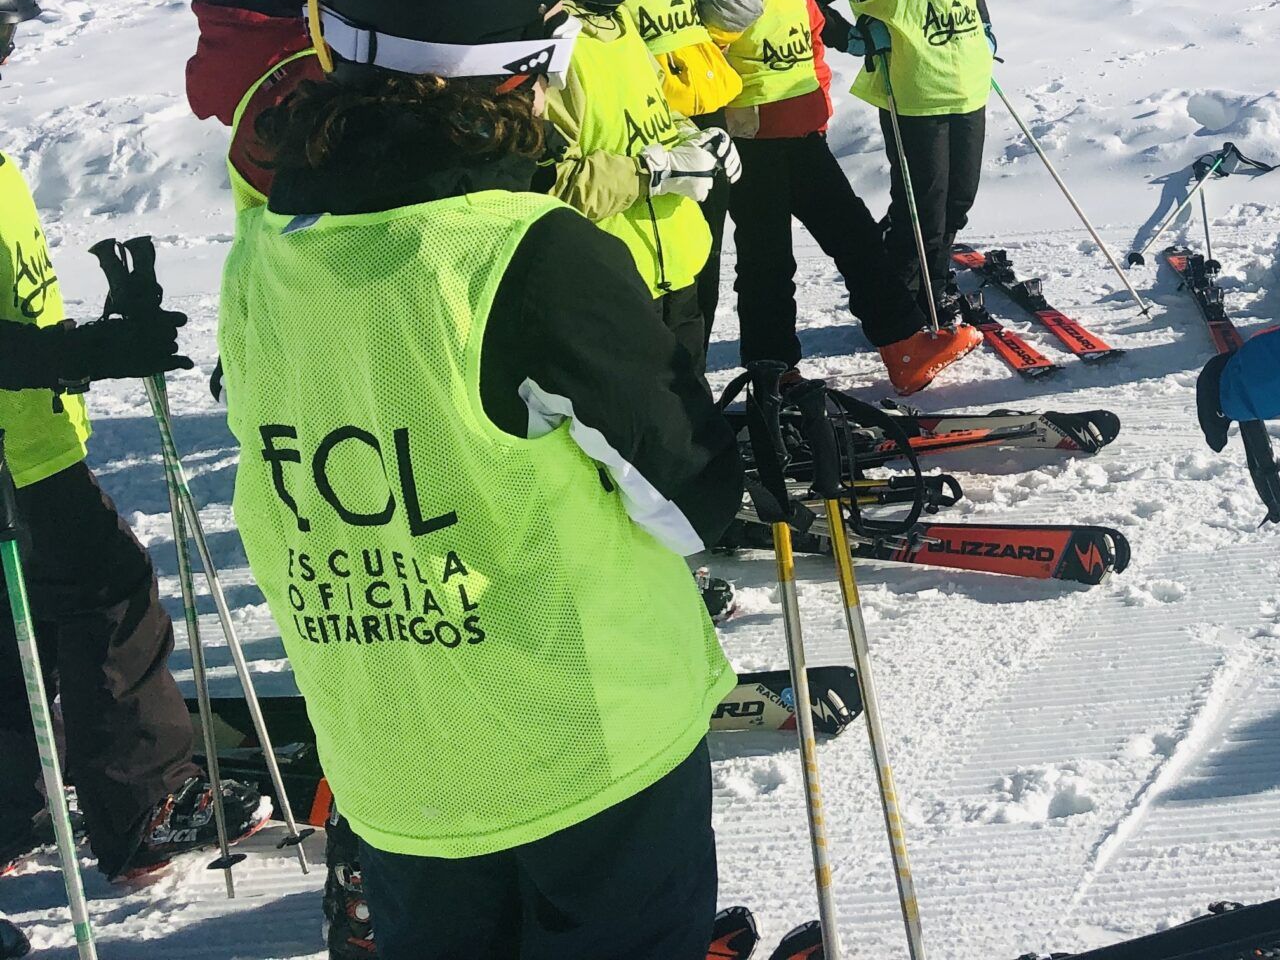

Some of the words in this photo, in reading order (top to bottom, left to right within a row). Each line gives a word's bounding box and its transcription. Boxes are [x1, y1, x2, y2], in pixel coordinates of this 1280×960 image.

[258, 423, 459, 538] FOL
[288, 581, 479, 616] OFICIAL
[293, 613, 487, 649] LEITARIEGOS
